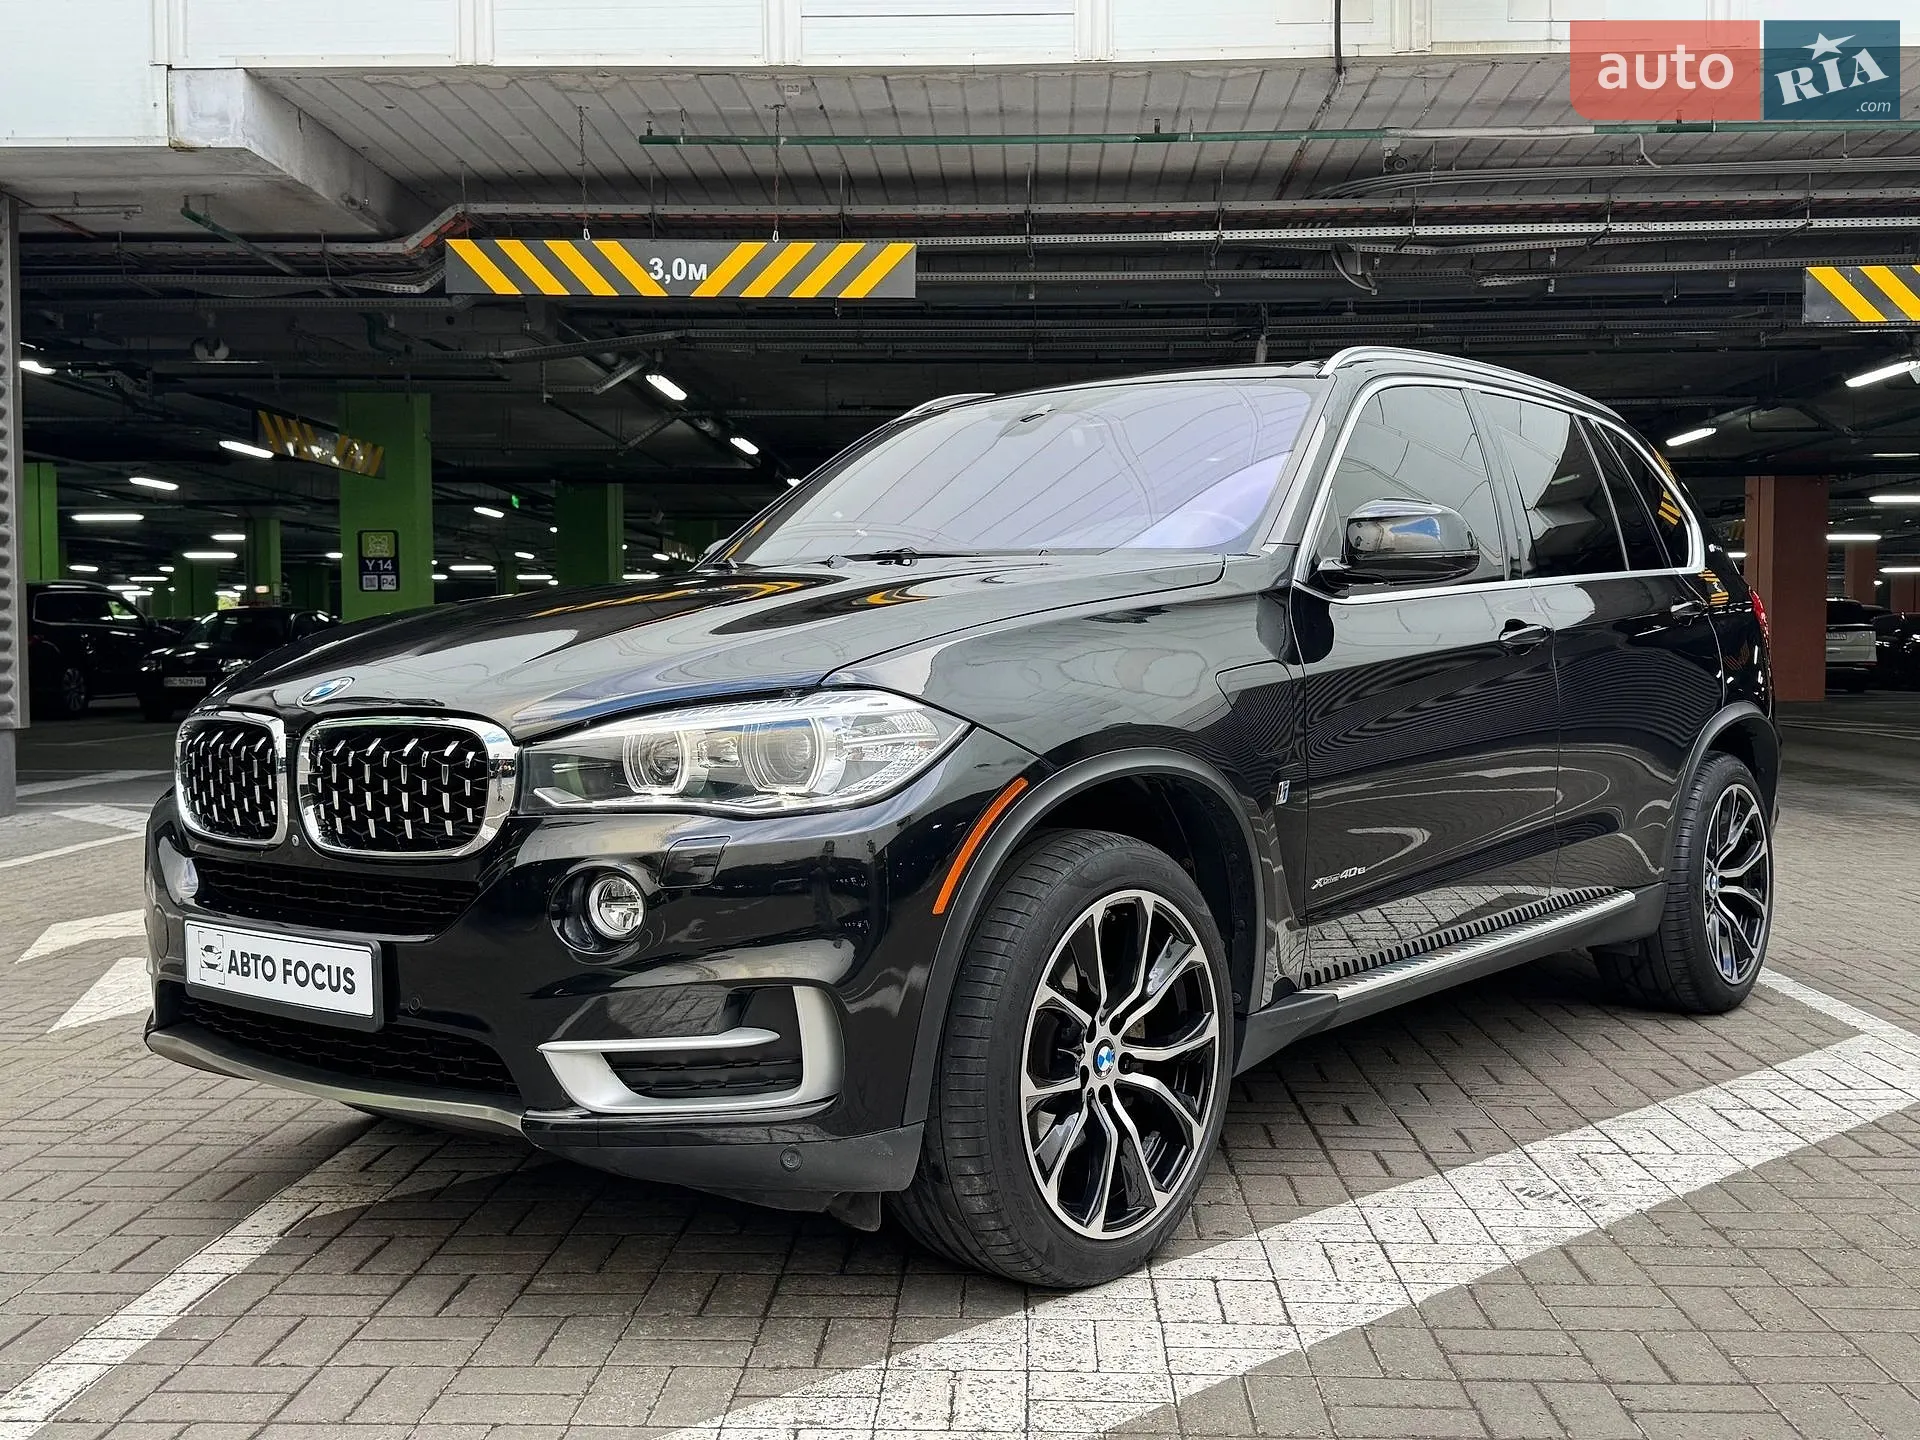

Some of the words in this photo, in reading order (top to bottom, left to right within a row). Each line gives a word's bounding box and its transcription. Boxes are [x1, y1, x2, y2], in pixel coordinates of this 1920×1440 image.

[365, 559, 375, 571] Y
[377, 559, 393, 571] 14
[282, 958, 356, 995] FOCUS
